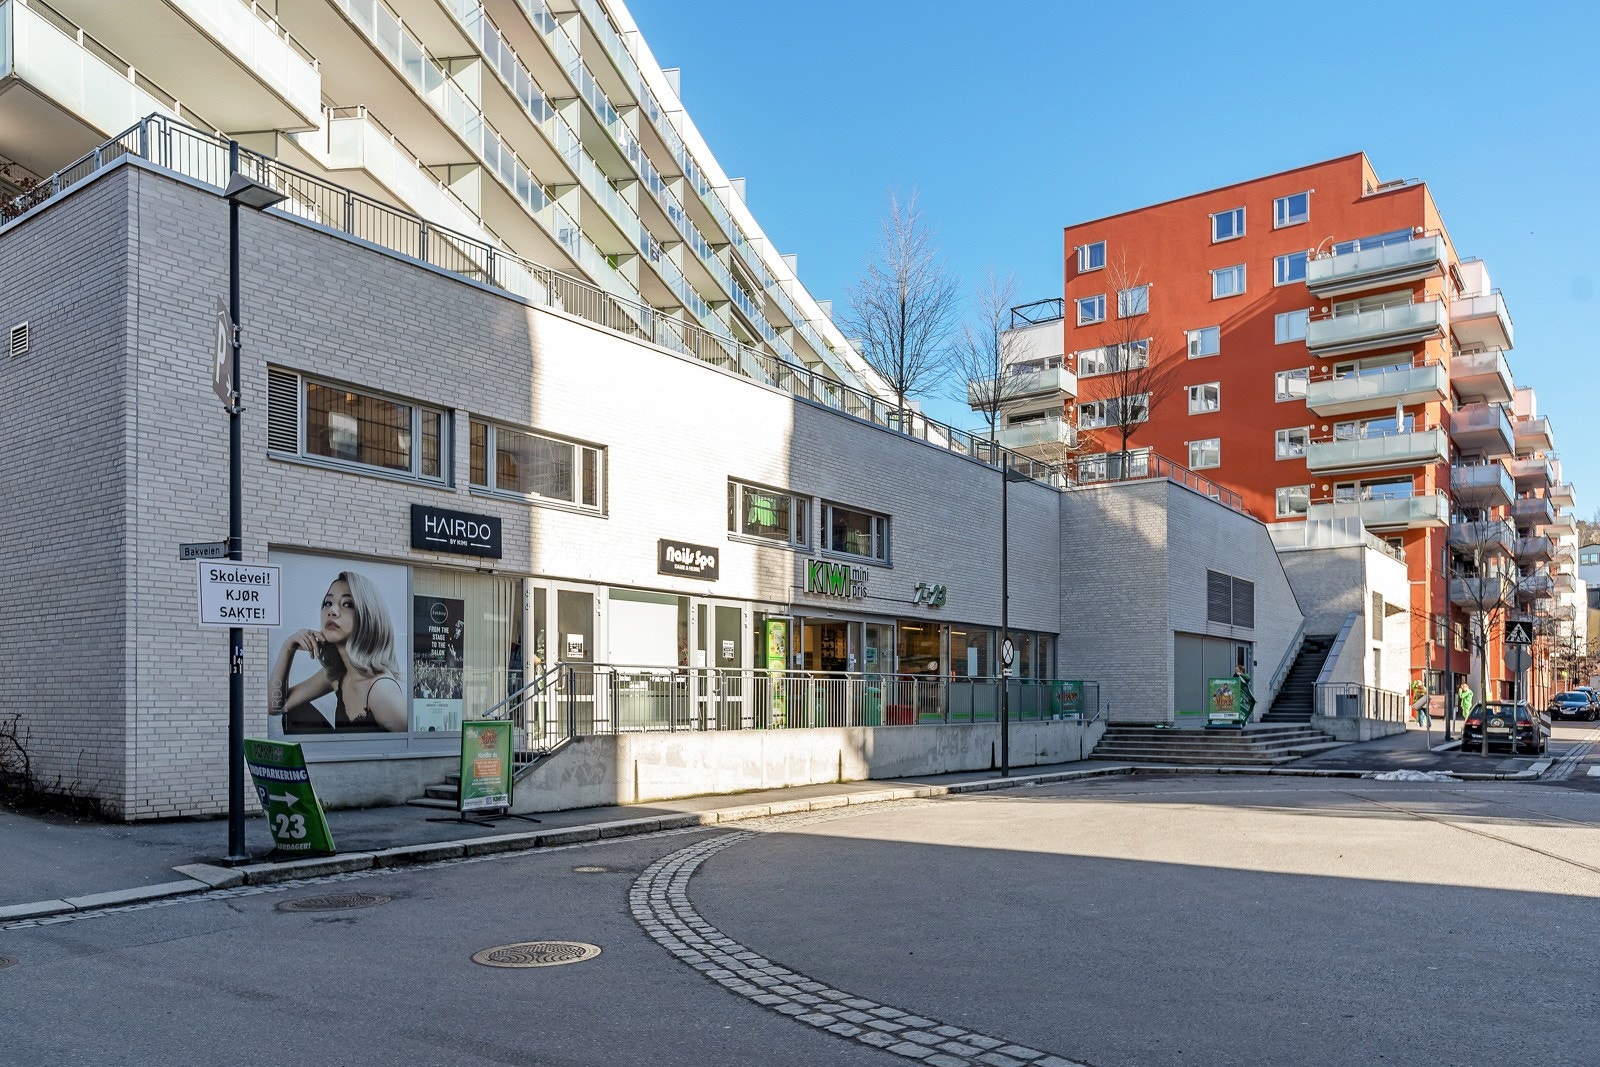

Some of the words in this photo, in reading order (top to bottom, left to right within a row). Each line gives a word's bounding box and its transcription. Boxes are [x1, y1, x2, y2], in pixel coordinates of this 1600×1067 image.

[425, 514, 491, 540] HAIRDO
[184, 547, 220, 557] Bakveien
[695, 550, 715, 570] Spa
[210, 569, 271, 584] Skolevei!
[804, 559, 850, 597] KIWI
[852, 567, 869, 581] mini
[226, 589, 259, 602] KJØR
[852, 583, 868, 598] pris
[219, 606, 265, 619] SAKTE!
[441, 626, 449, 634] THE
